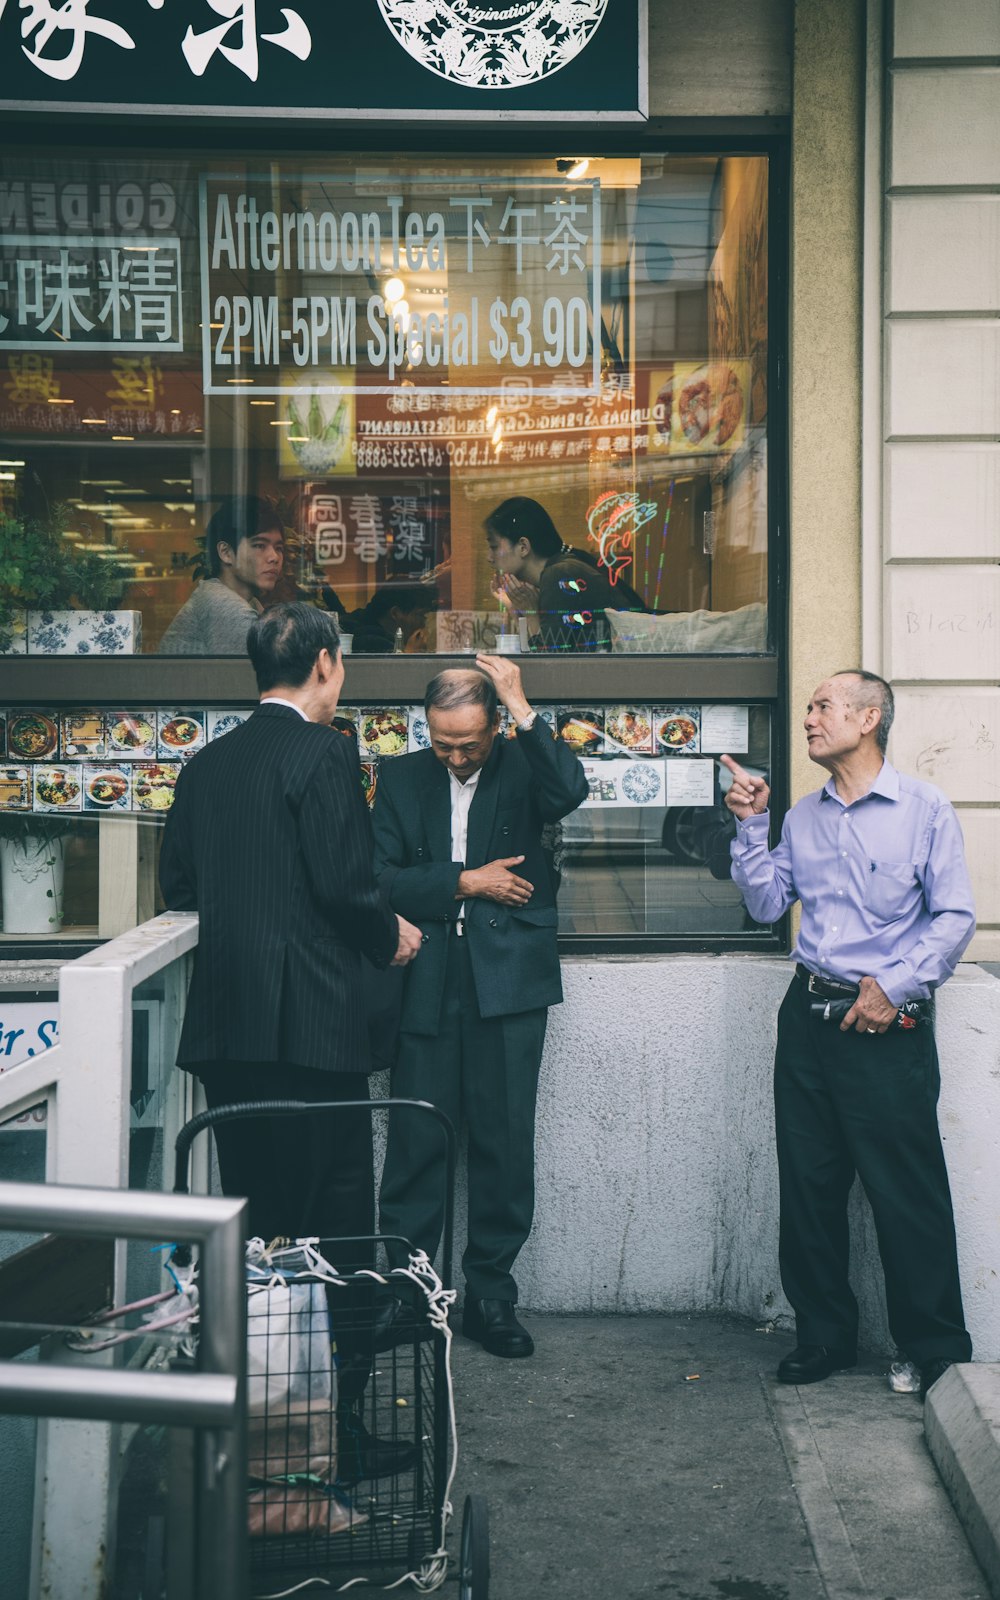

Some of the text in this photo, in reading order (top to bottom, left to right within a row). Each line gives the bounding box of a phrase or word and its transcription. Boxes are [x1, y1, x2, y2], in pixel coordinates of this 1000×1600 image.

[451, 0, 538, 25] Origination
[212, 193, 590, 276] Afternoon Tea 下午茶
[0, 249, 176, 342] 味精
[213, 294, 589, 380] 2PM-5PM Special $3.90
